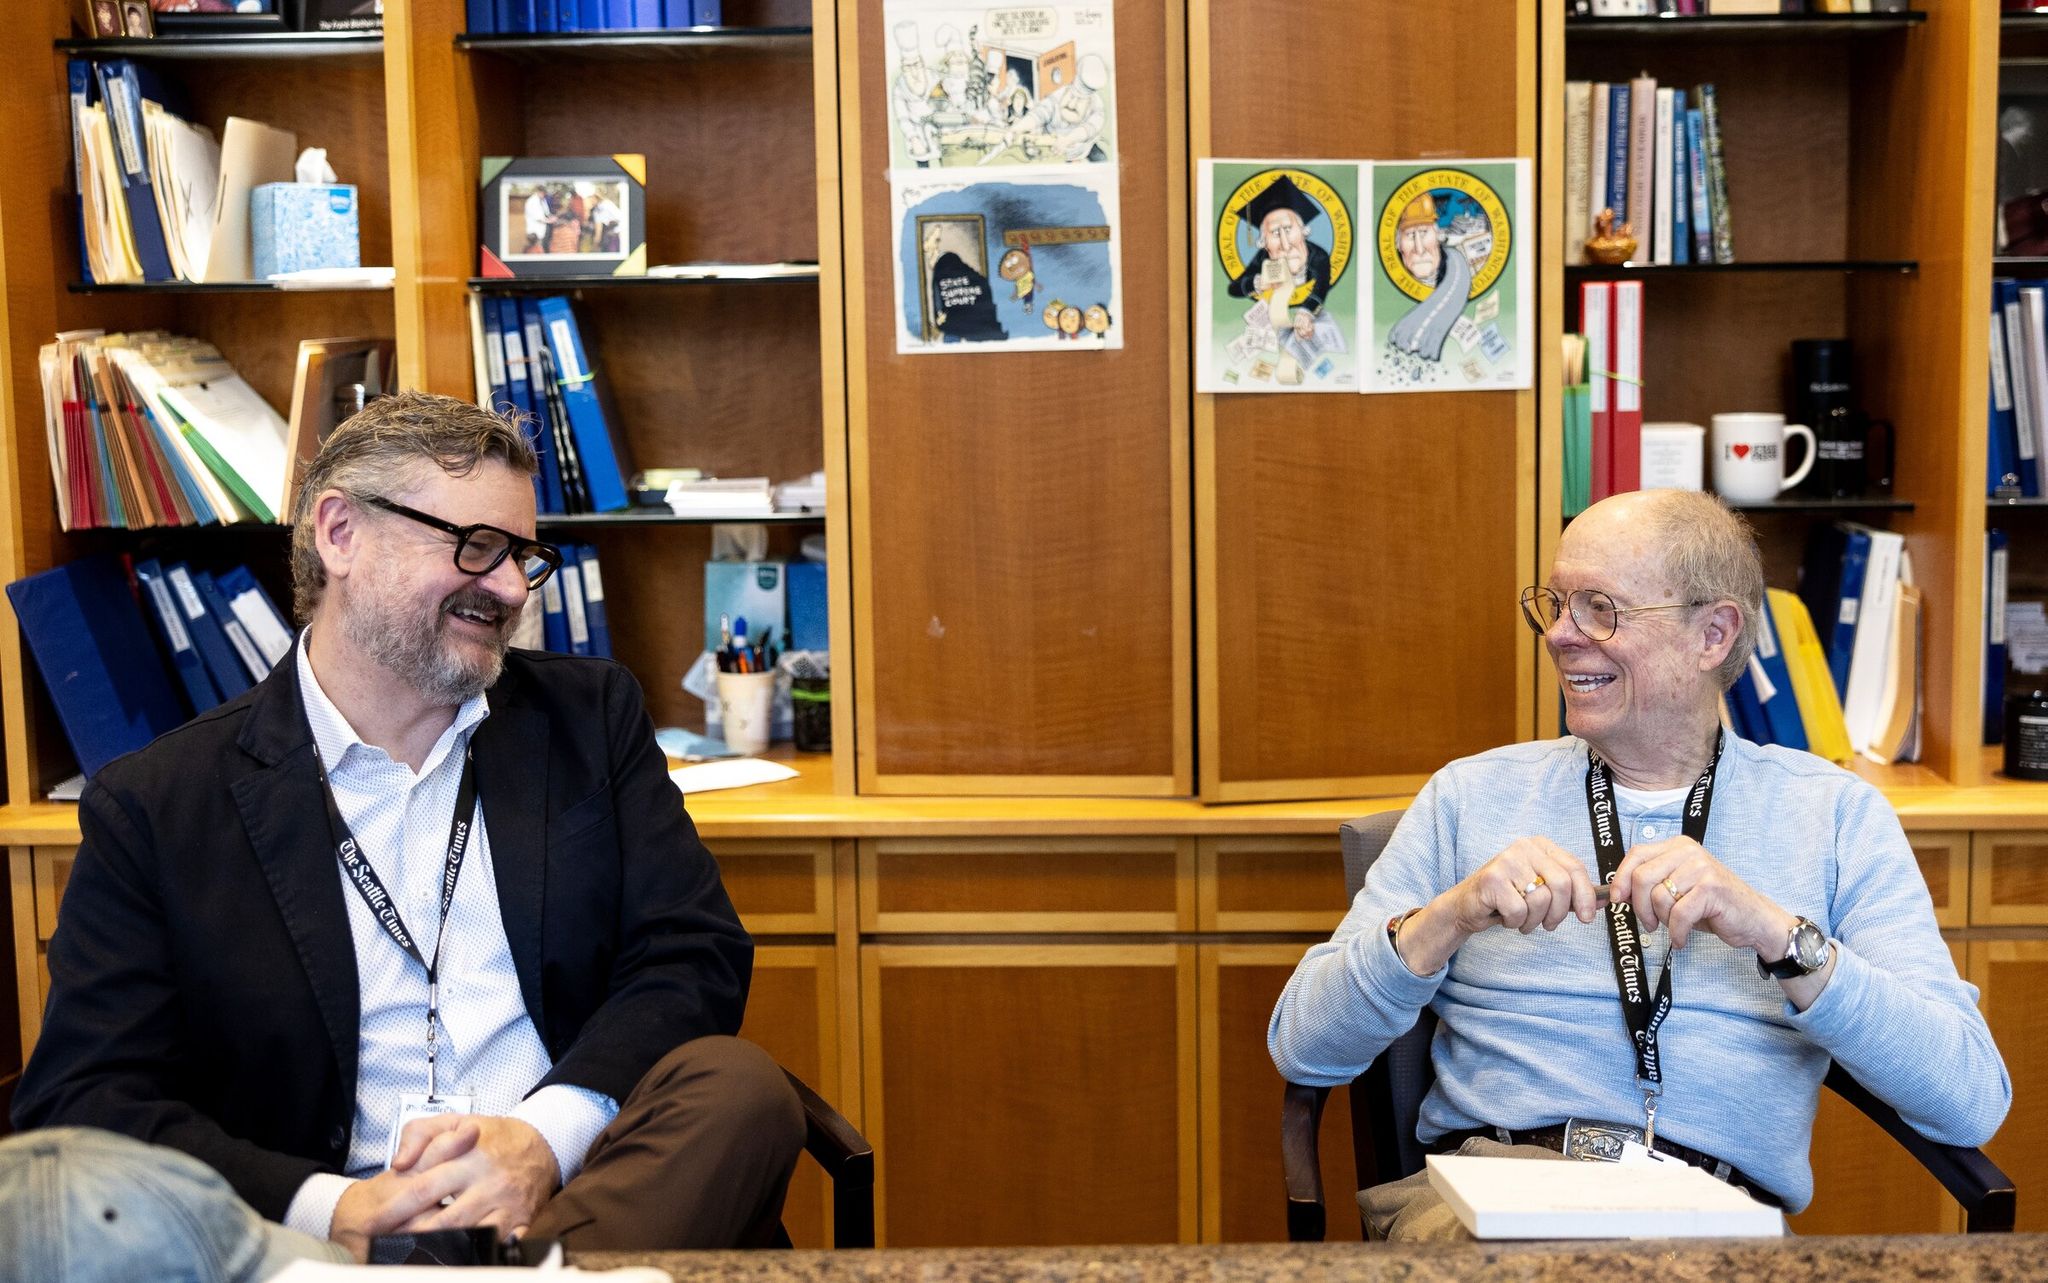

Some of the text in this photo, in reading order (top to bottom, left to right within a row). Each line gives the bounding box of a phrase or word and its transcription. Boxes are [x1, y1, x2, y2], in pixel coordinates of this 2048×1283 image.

[1240, 181, 1264, 201] THE
[1317, 187, 1333, 202] OF
[1385, 208, 1397, 228] OF
[1398, 182, 1420, 203] THE
[1427, 175, 1470, 188] STATE
[1474, 186, 1491, 203] OF
[940, 276, 970, 290] STATE
[941, 286, 983, 300] SUPREME
[944, 295, 977, 308] COURT
[1689, 775, 1712, 818] Times
[447, 820, 467, 865] Times
[1593, 799, 1614, 847] Times
[340, 838, 412, 948] The Seattle Times
[1610, 902, 1636, 955] Seattle
[1619, 953, 1643, 1004] Times
[1643, 994, 1671, 1082] attle Times
[420, 1104, 443, 1113] Seattle
